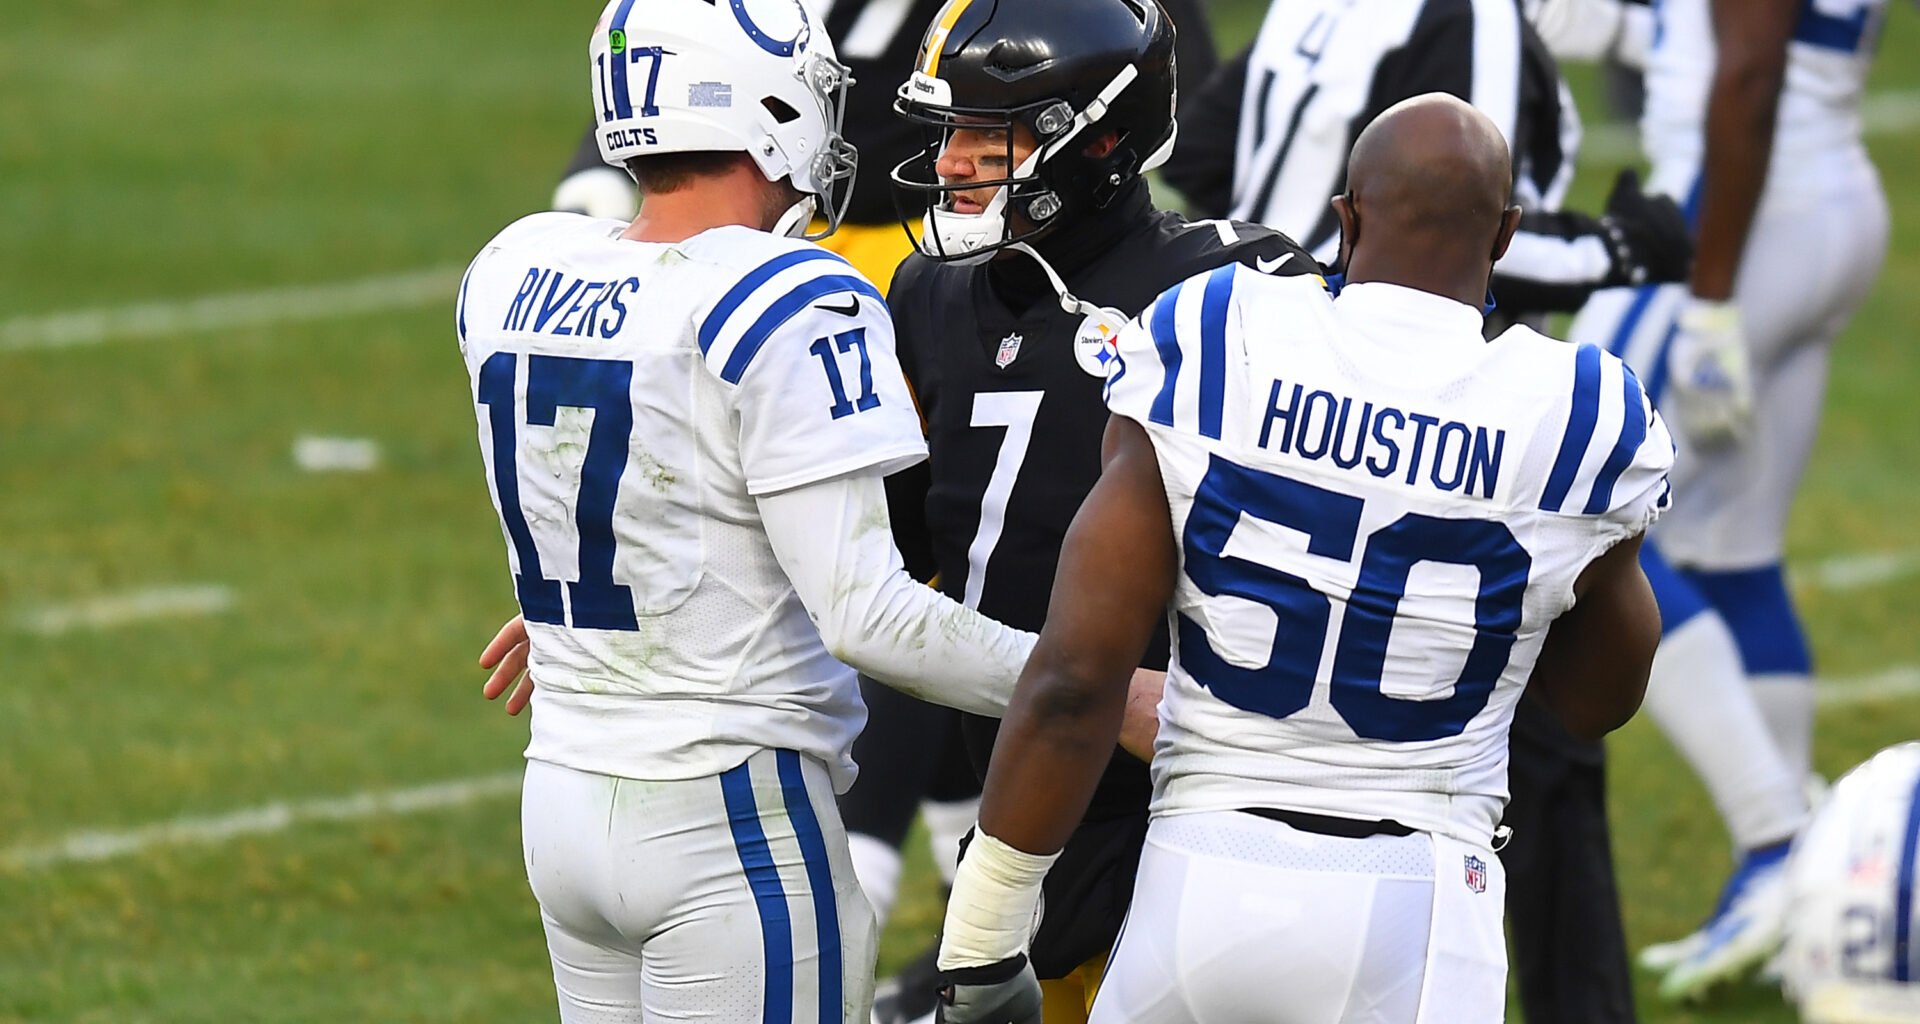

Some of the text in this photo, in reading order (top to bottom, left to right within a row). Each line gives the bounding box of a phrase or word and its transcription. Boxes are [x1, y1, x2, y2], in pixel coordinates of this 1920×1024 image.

[598, 46, 662, 122] 17
[606, 127, 658, 151] COLTS
[503, 267, 640, 339] RIVERS
[809, 327, 882, 421] 17
[1257, 379, 1506, 499] HOUSTON
[478, 351, 640, 631] 17
[963, 390, 1046, 612] 7
[1178, 452, 1532, 743] 50
[1467, 869, 1486, 889] NFL
